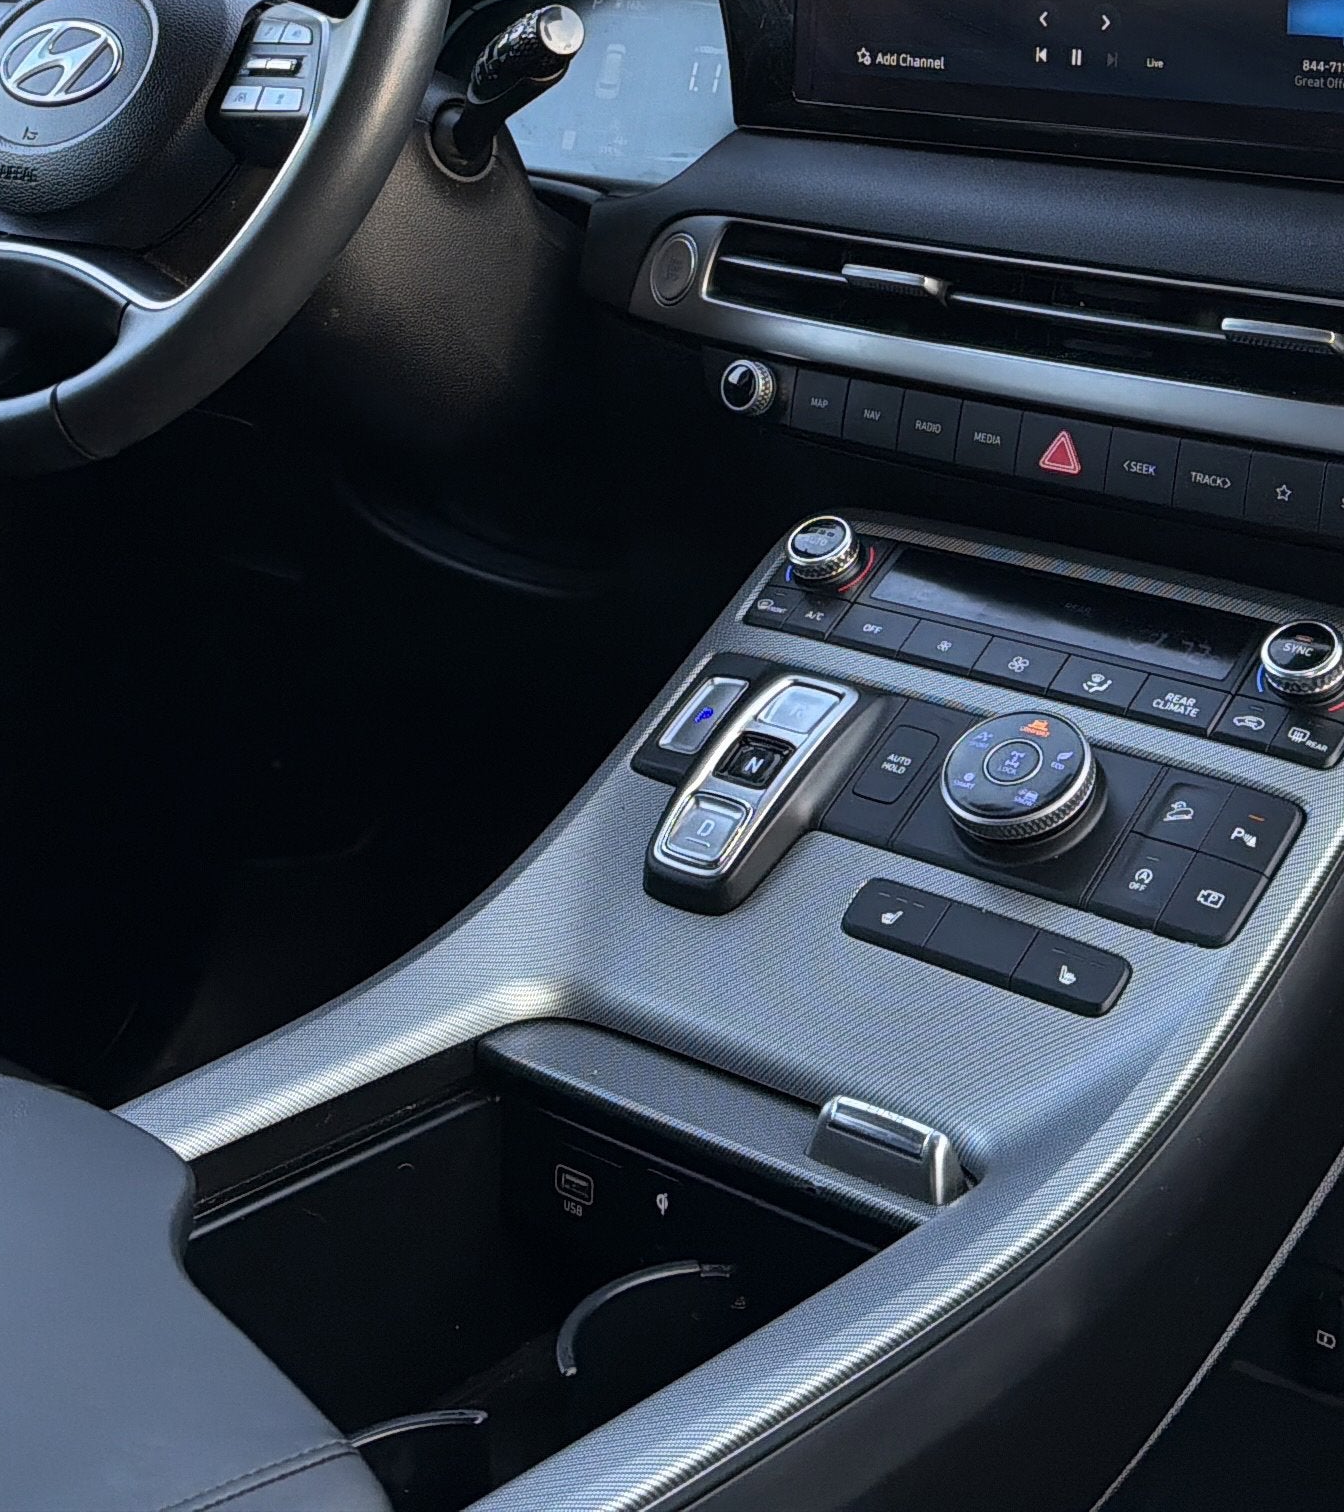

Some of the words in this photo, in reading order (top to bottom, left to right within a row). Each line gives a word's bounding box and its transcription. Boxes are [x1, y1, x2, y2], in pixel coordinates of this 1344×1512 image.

[875, 52, 897, 66] Add
[899, 53, 945, 70] Channel
[1146, 58, 1164, 68] Live
[1294, 75, 1324, 88] Great
[810, 397, 829, 409] MAP
[863, 409, 881, 421] NAV
[915, 420, 942, 434] RADIO
[973, 431, 1001, 446] MEDIA
[1130, 462, 1156, 476] SEEK
[1190, 471, 1224, 487] TRACK
[862, 623, 883, 634] OFF
[1282, 642, 1315, 657] SYNC
[1164, 692, 1197, 706] REAR
[1152, 698, 1200, 718] CLIMATE
[1305, 739, 1328, 753] REAR
[744, 756, 764, 773] N
[886, 752, 912, 766] AUTO
[880, 761, 907, 775] HOLD
[696, 819, 716, 837] D
[1128, 881, 1148, 892] OFF
[563, 1199, 583, 1217] USB
